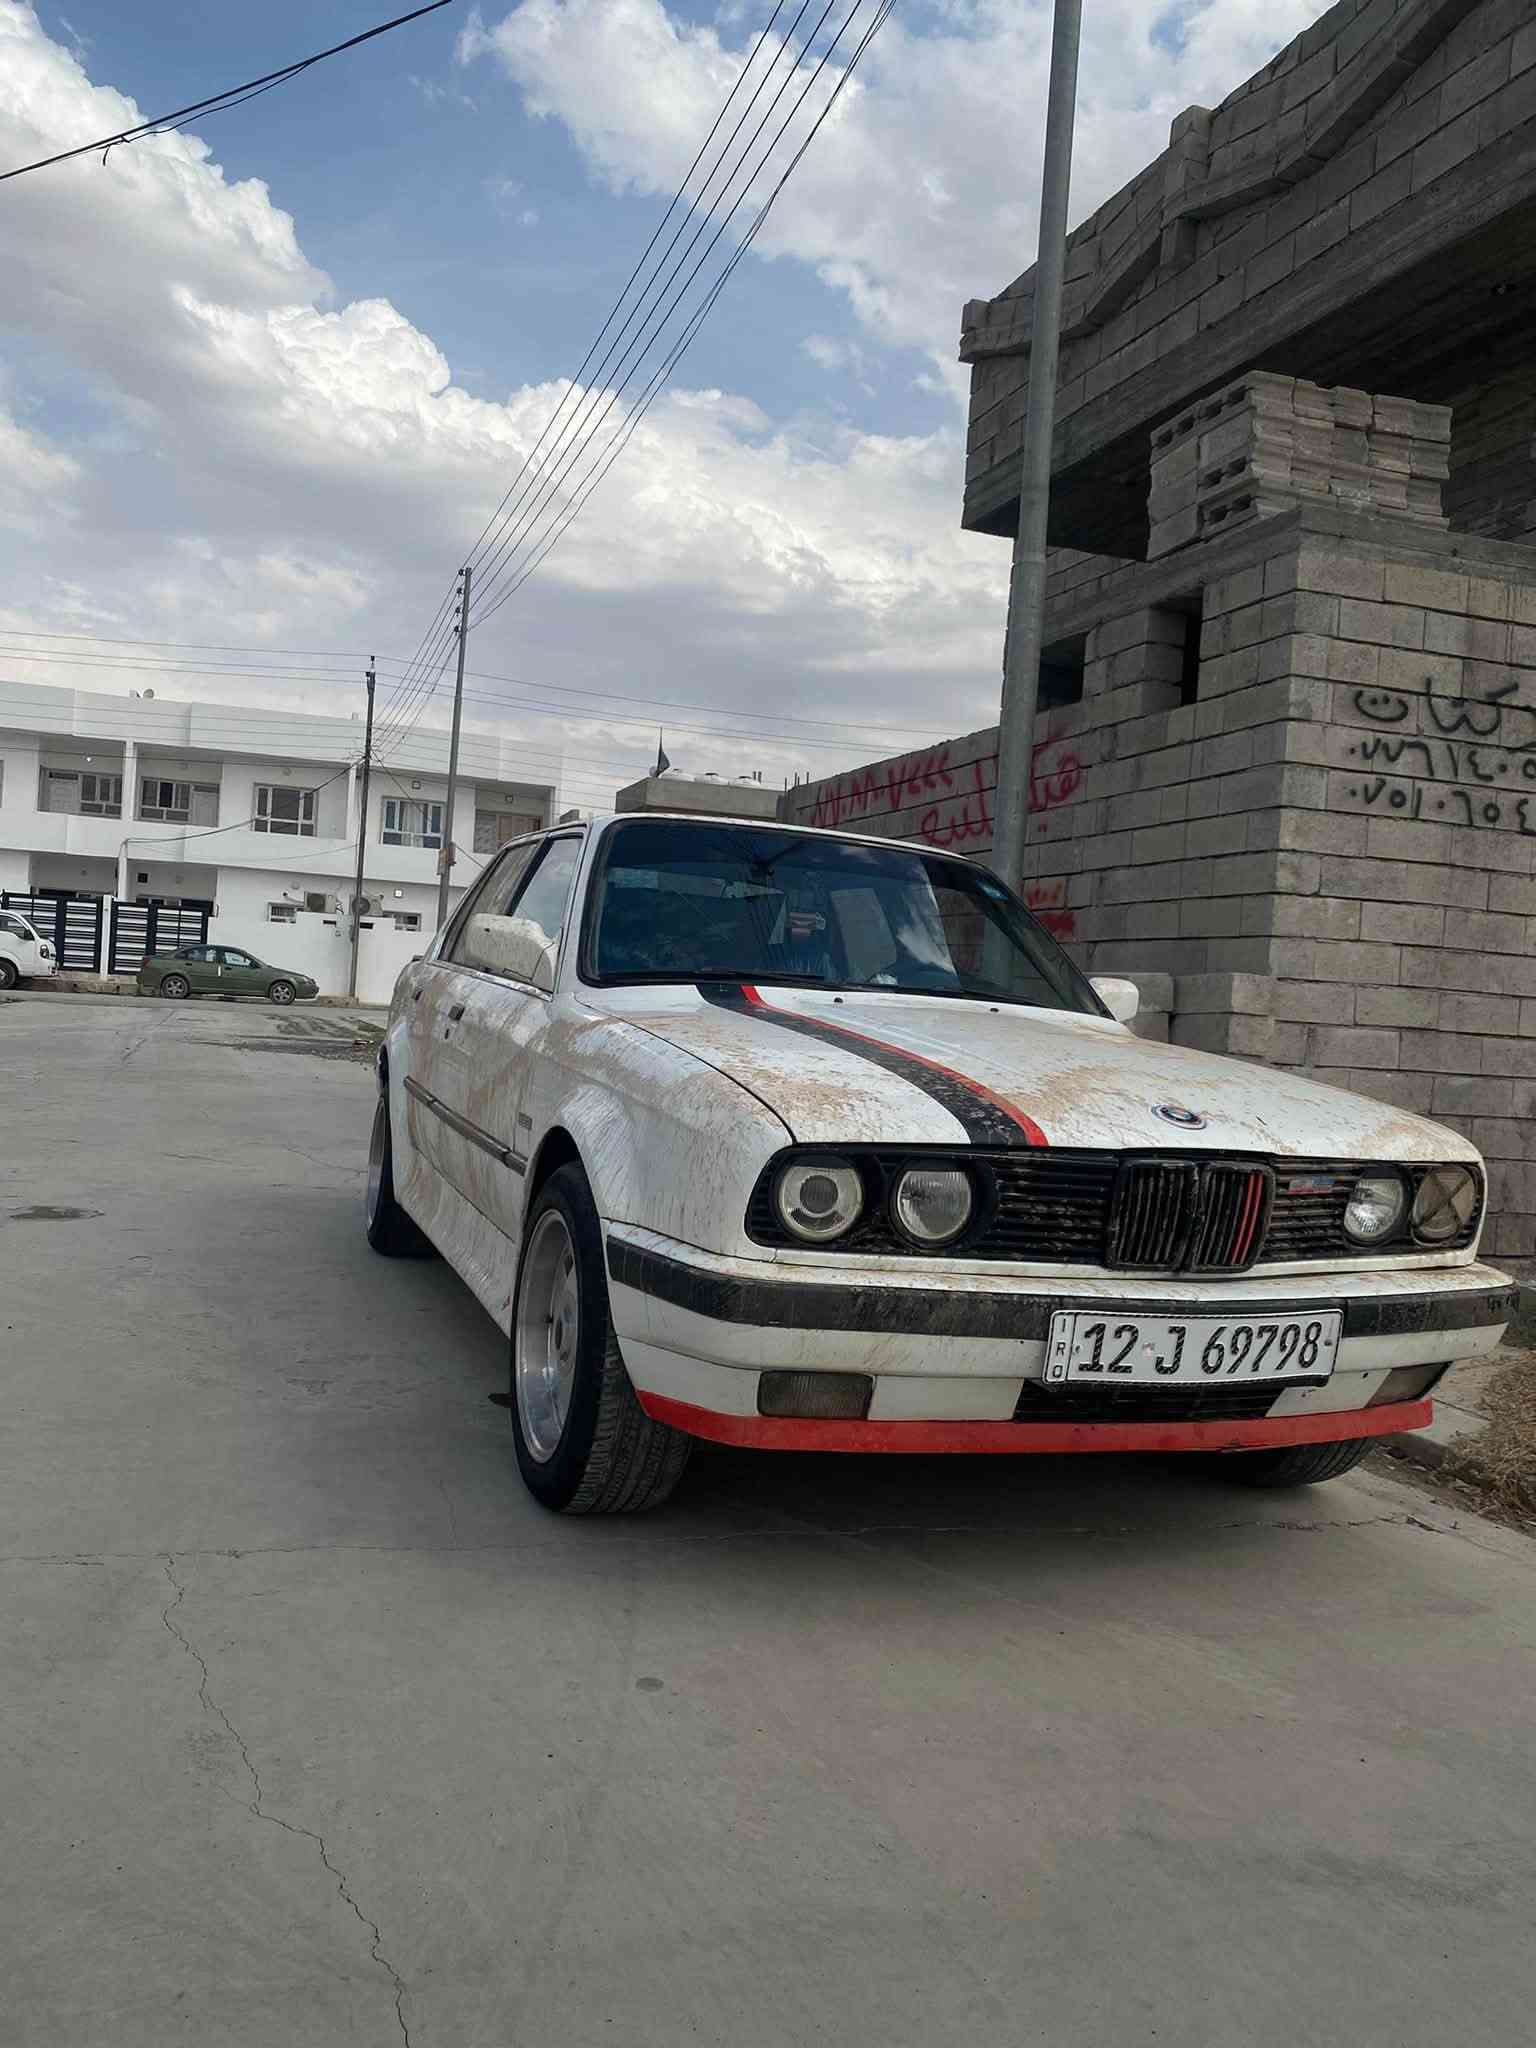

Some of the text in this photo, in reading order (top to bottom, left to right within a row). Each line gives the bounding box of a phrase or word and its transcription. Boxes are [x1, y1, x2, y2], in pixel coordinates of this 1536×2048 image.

[1078, 1321, 1322, 1376] 12 J 69798
